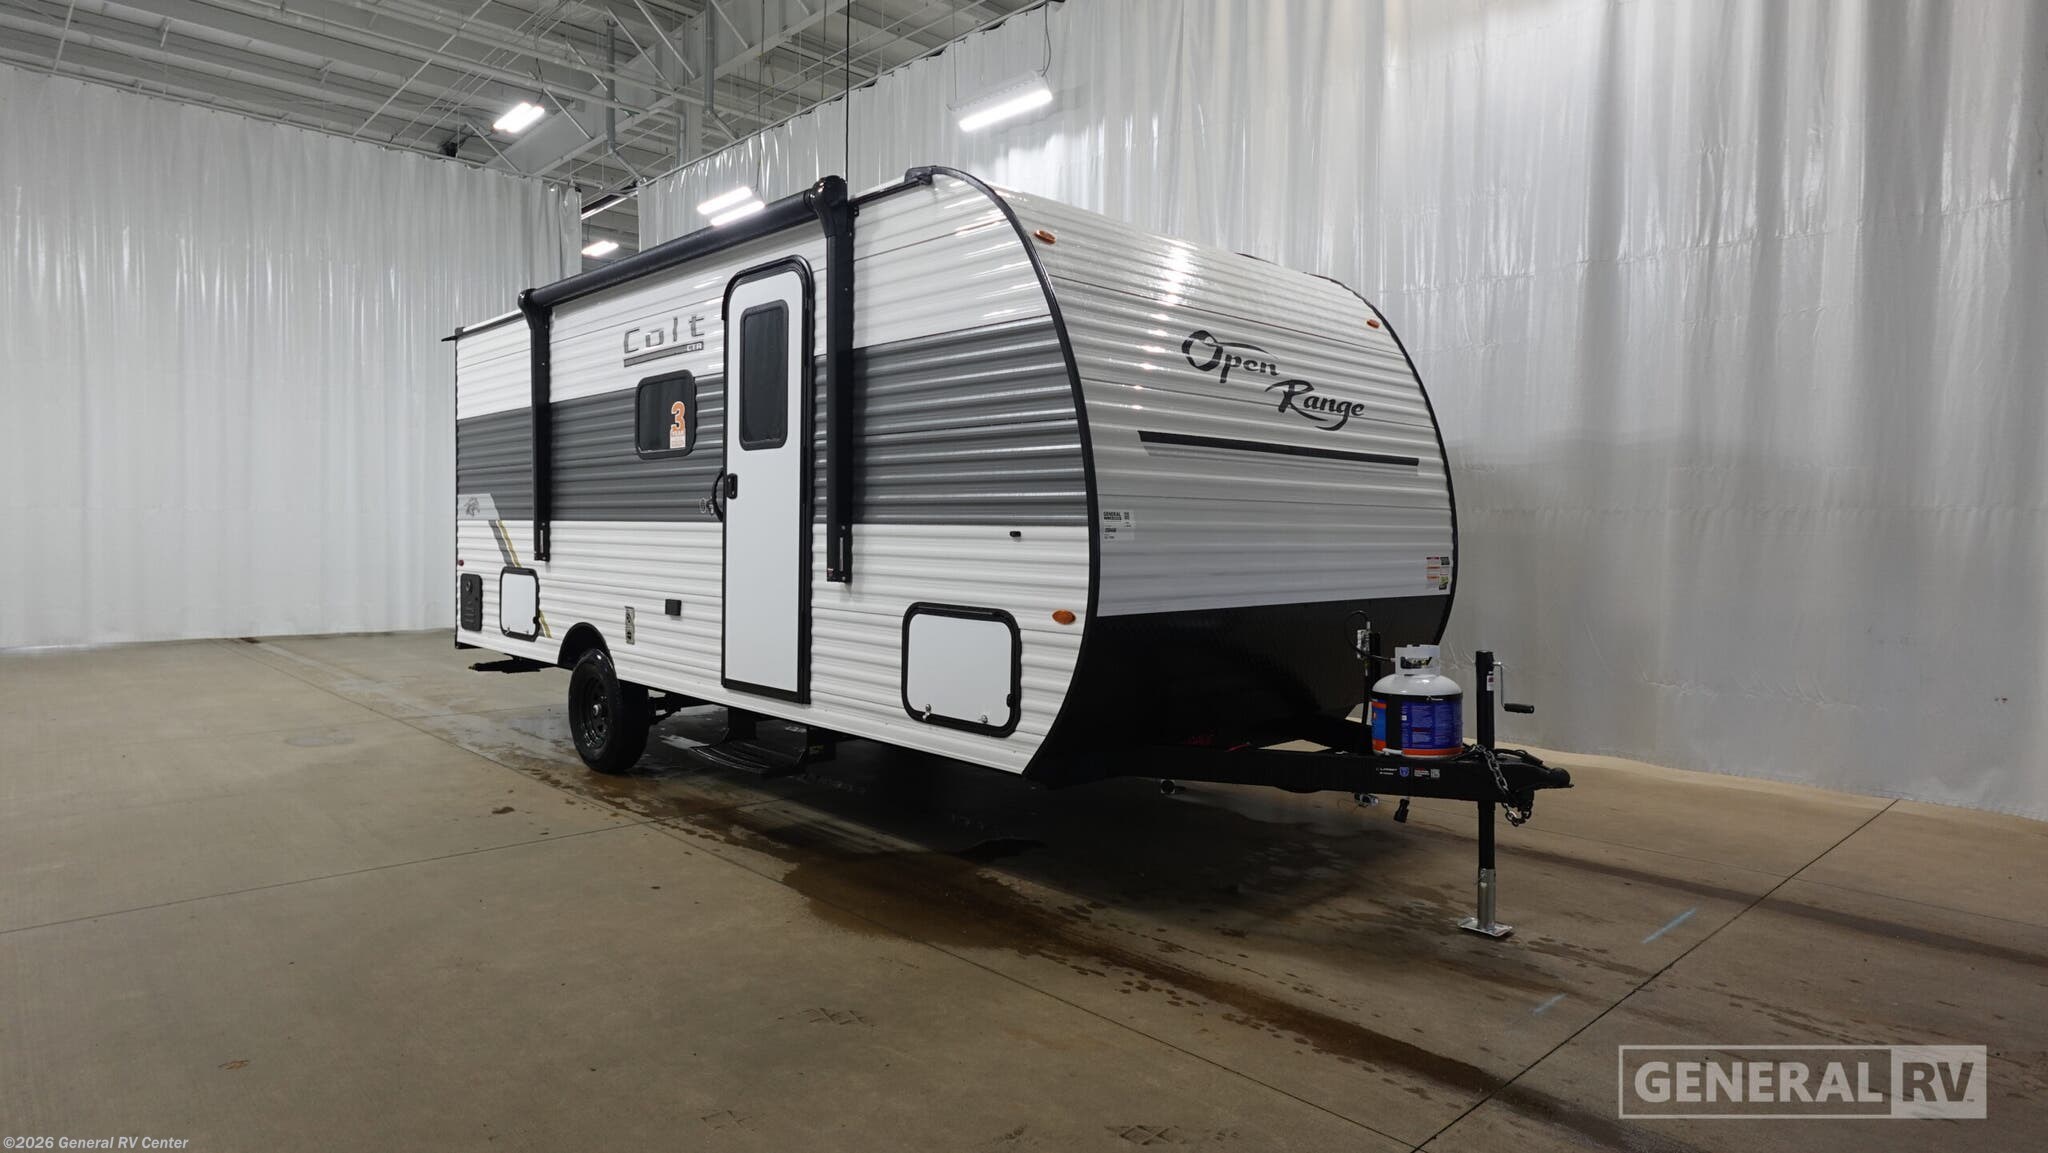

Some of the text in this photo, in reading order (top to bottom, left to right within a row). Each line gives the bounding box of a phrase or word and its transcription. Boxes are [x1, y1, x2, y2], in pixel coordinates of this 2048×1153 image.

[623, 315, 705, 354] Colt
[1181, 330, 1280, 384] Open
[671, 401, 686, 432] 3
[1264, 379, 1365, 431] Range
